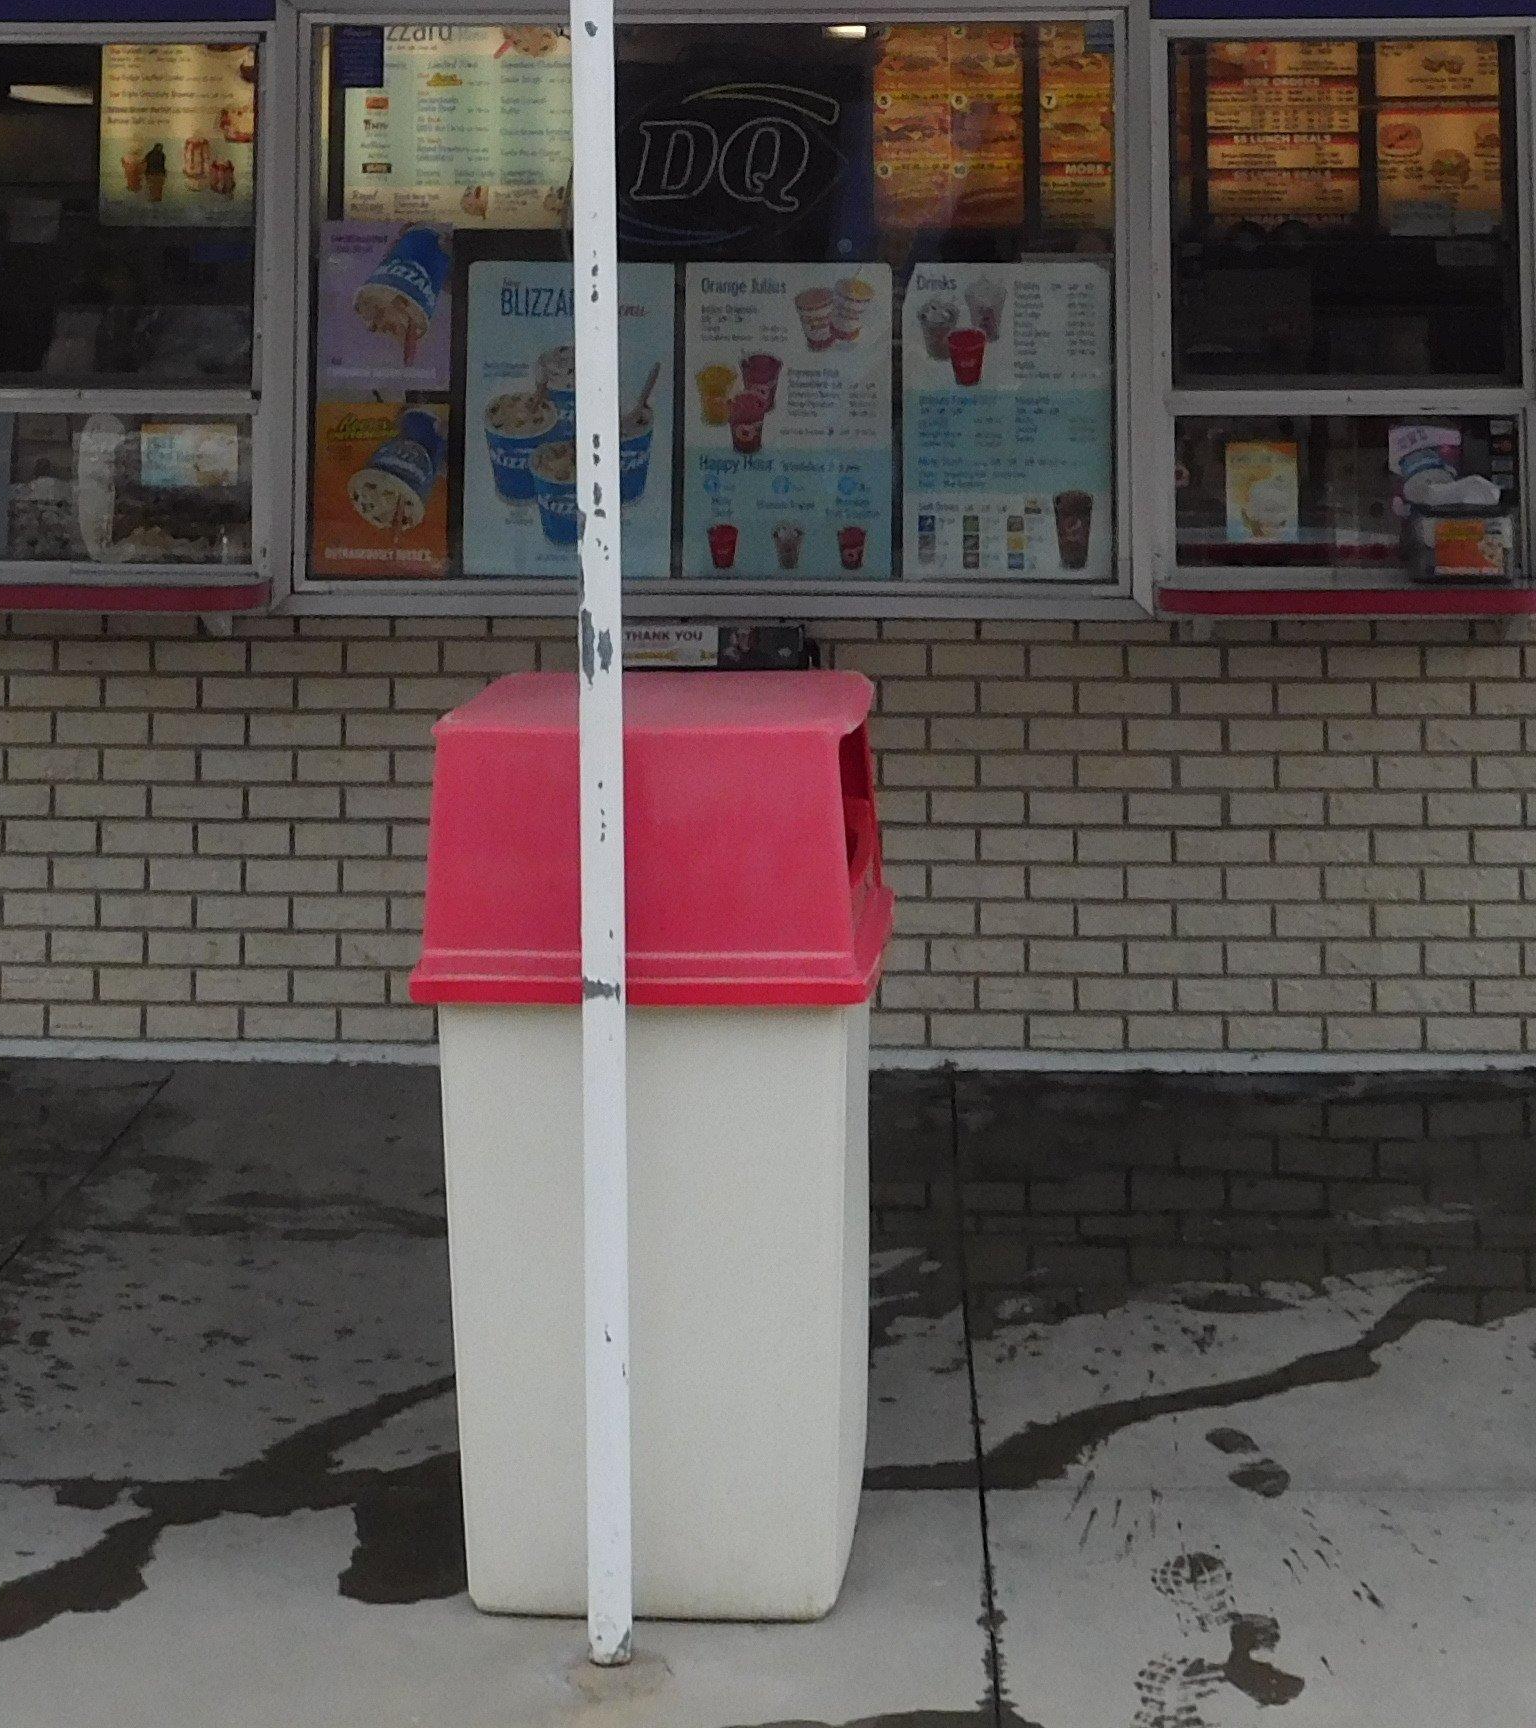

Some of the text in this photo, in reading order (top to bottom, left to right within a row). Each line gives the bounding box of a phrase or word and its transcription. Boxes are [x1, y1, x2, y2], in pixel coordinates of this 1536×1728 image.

[630, 117, 809, 212] DQ
[701, 277, 787, 297] Orange Julius
[917, 275, 958, 291] Drinks
[500, 288, 575, 317] BLIZZA
[699, 455, 740, 473] Happy
[744, 455, 775, 471] Hour
[626, 630, 703, 642] THANK YOU
